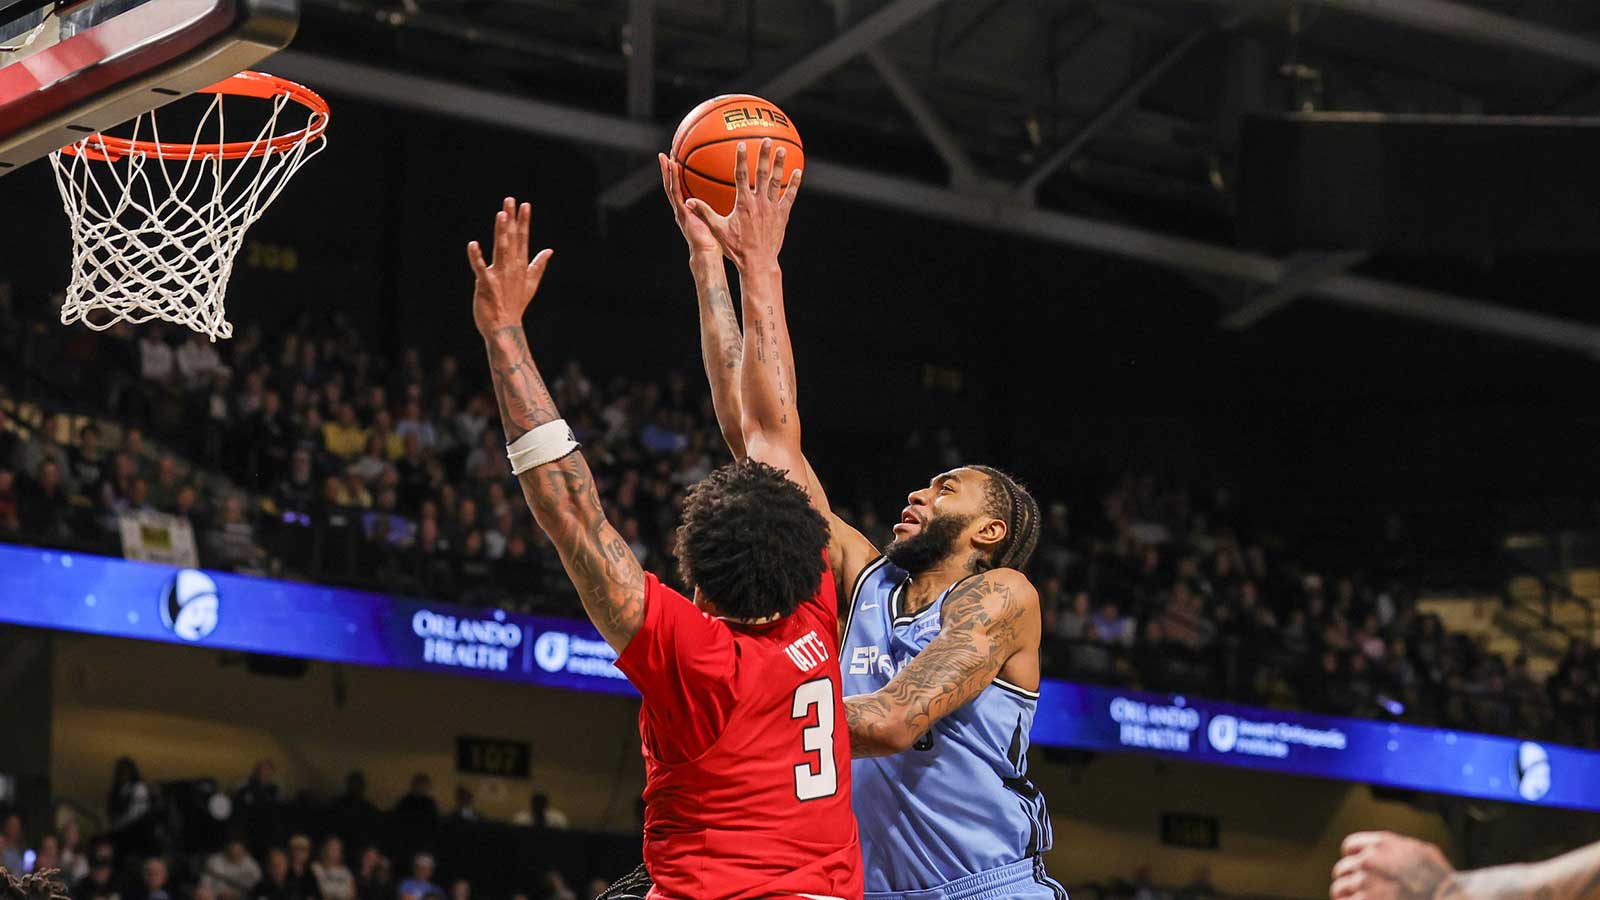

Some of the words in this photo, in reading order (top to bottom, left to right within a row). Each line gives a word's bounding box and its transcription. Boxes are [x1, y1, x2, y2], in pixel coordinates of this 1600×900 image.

[723, 108, 790, 128] ELITE
[412, 609, 522, 649] ORLANDO
[424, 637, 508, 672] HEALTH
[1109, 697, 1200, 732] ORLANDO
[791, 676, 839, 802] 3
